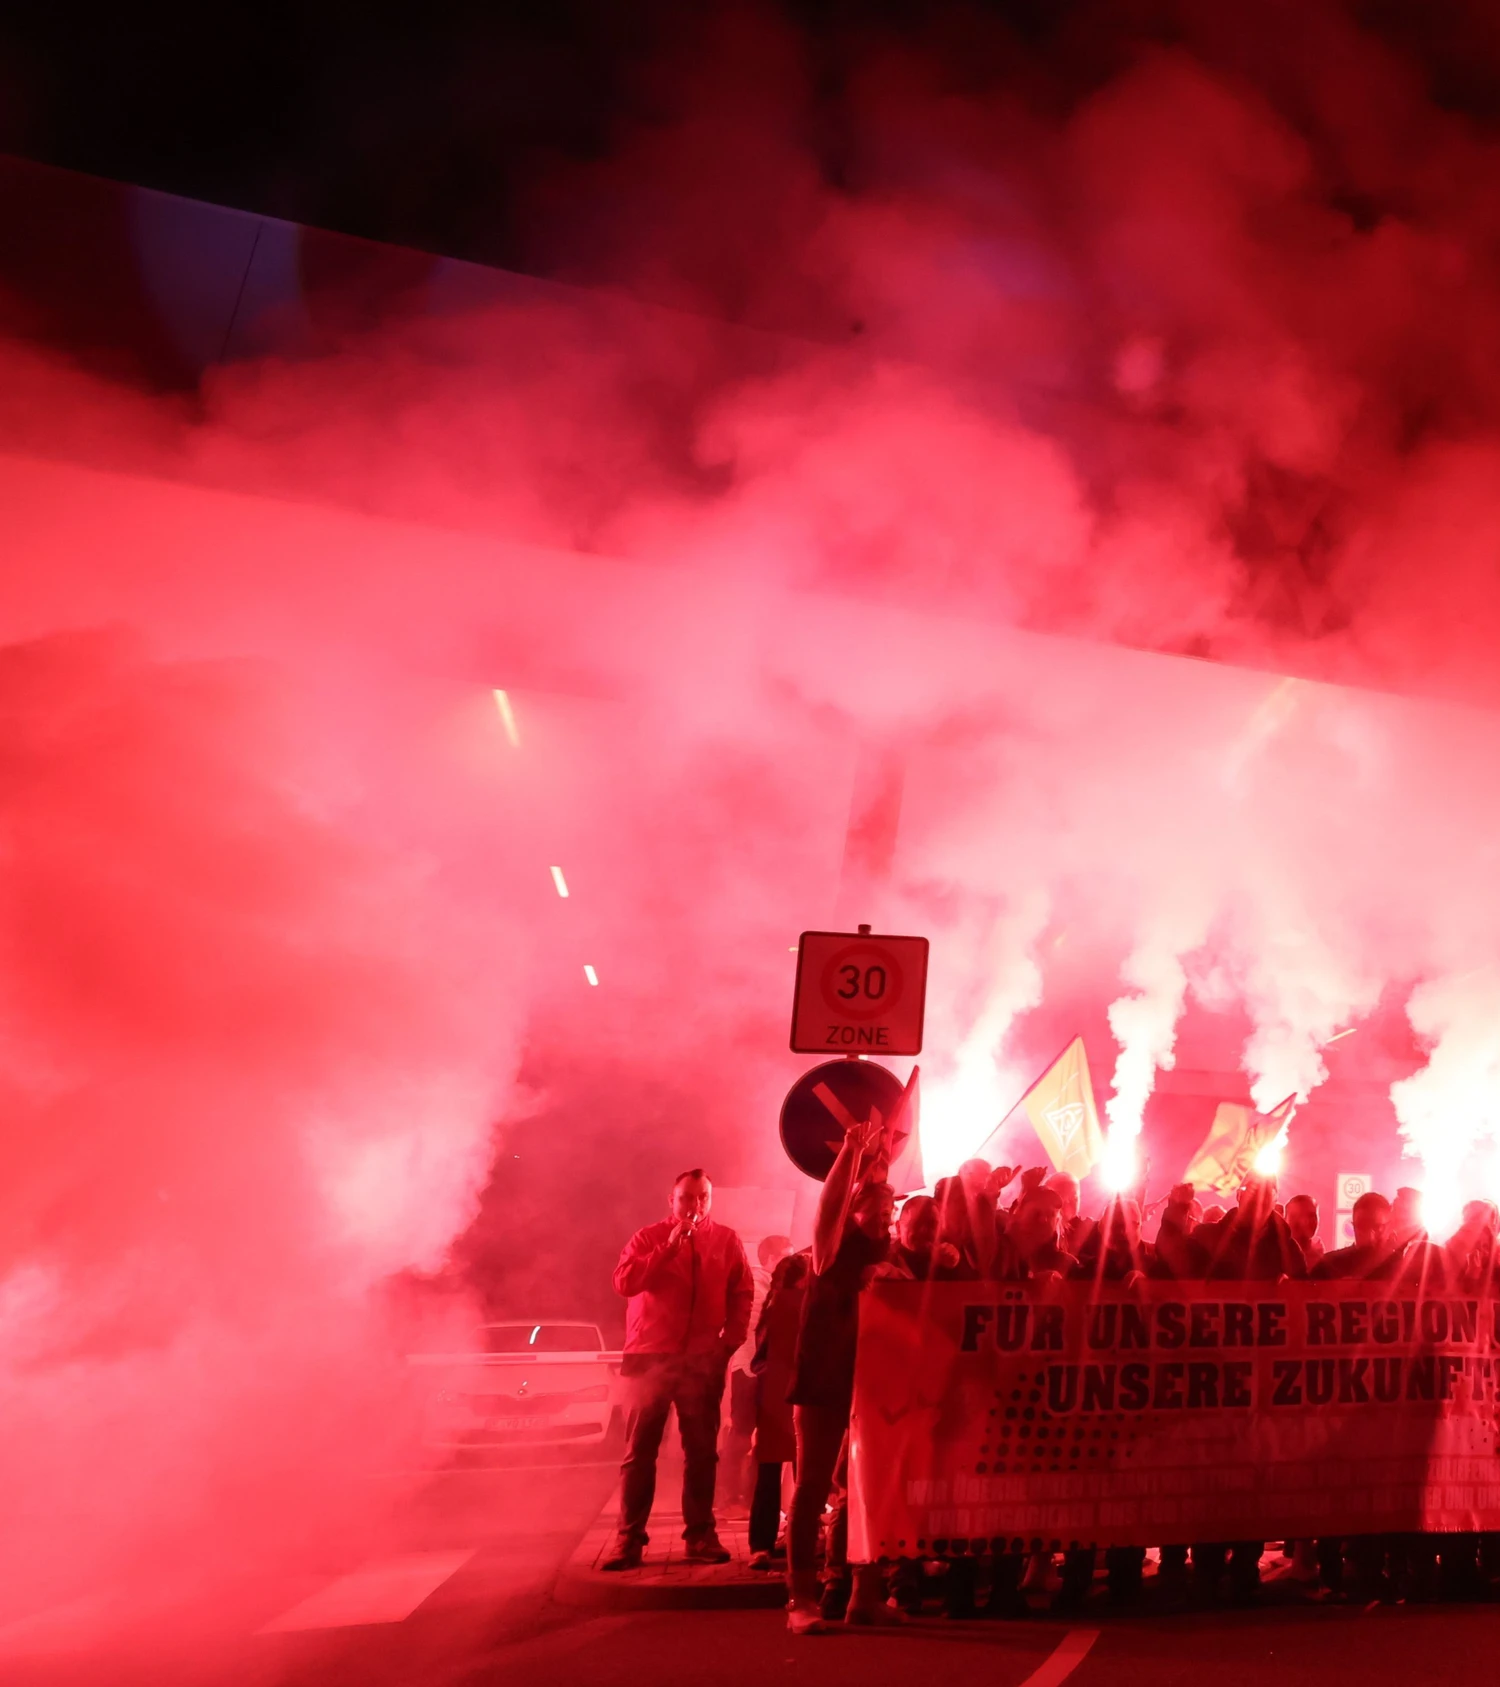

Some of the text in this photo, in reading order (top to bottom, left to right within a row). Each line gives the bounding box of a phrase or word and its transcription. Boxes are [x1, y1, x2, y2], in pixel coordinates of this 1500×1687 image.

[837, 965, 886, 1000] 30
[826, 1026, 889, 1046] ZONE
[1347, 1183, 1361, 1194] 30
[961, 1291, 1066, 1352] FÜR
[1087, 1302, 1287, 1350] UNSERE
[1305, 1300, 1478, 1346] REGION
[1046, 1360, 1253, 1413] UNSERE
